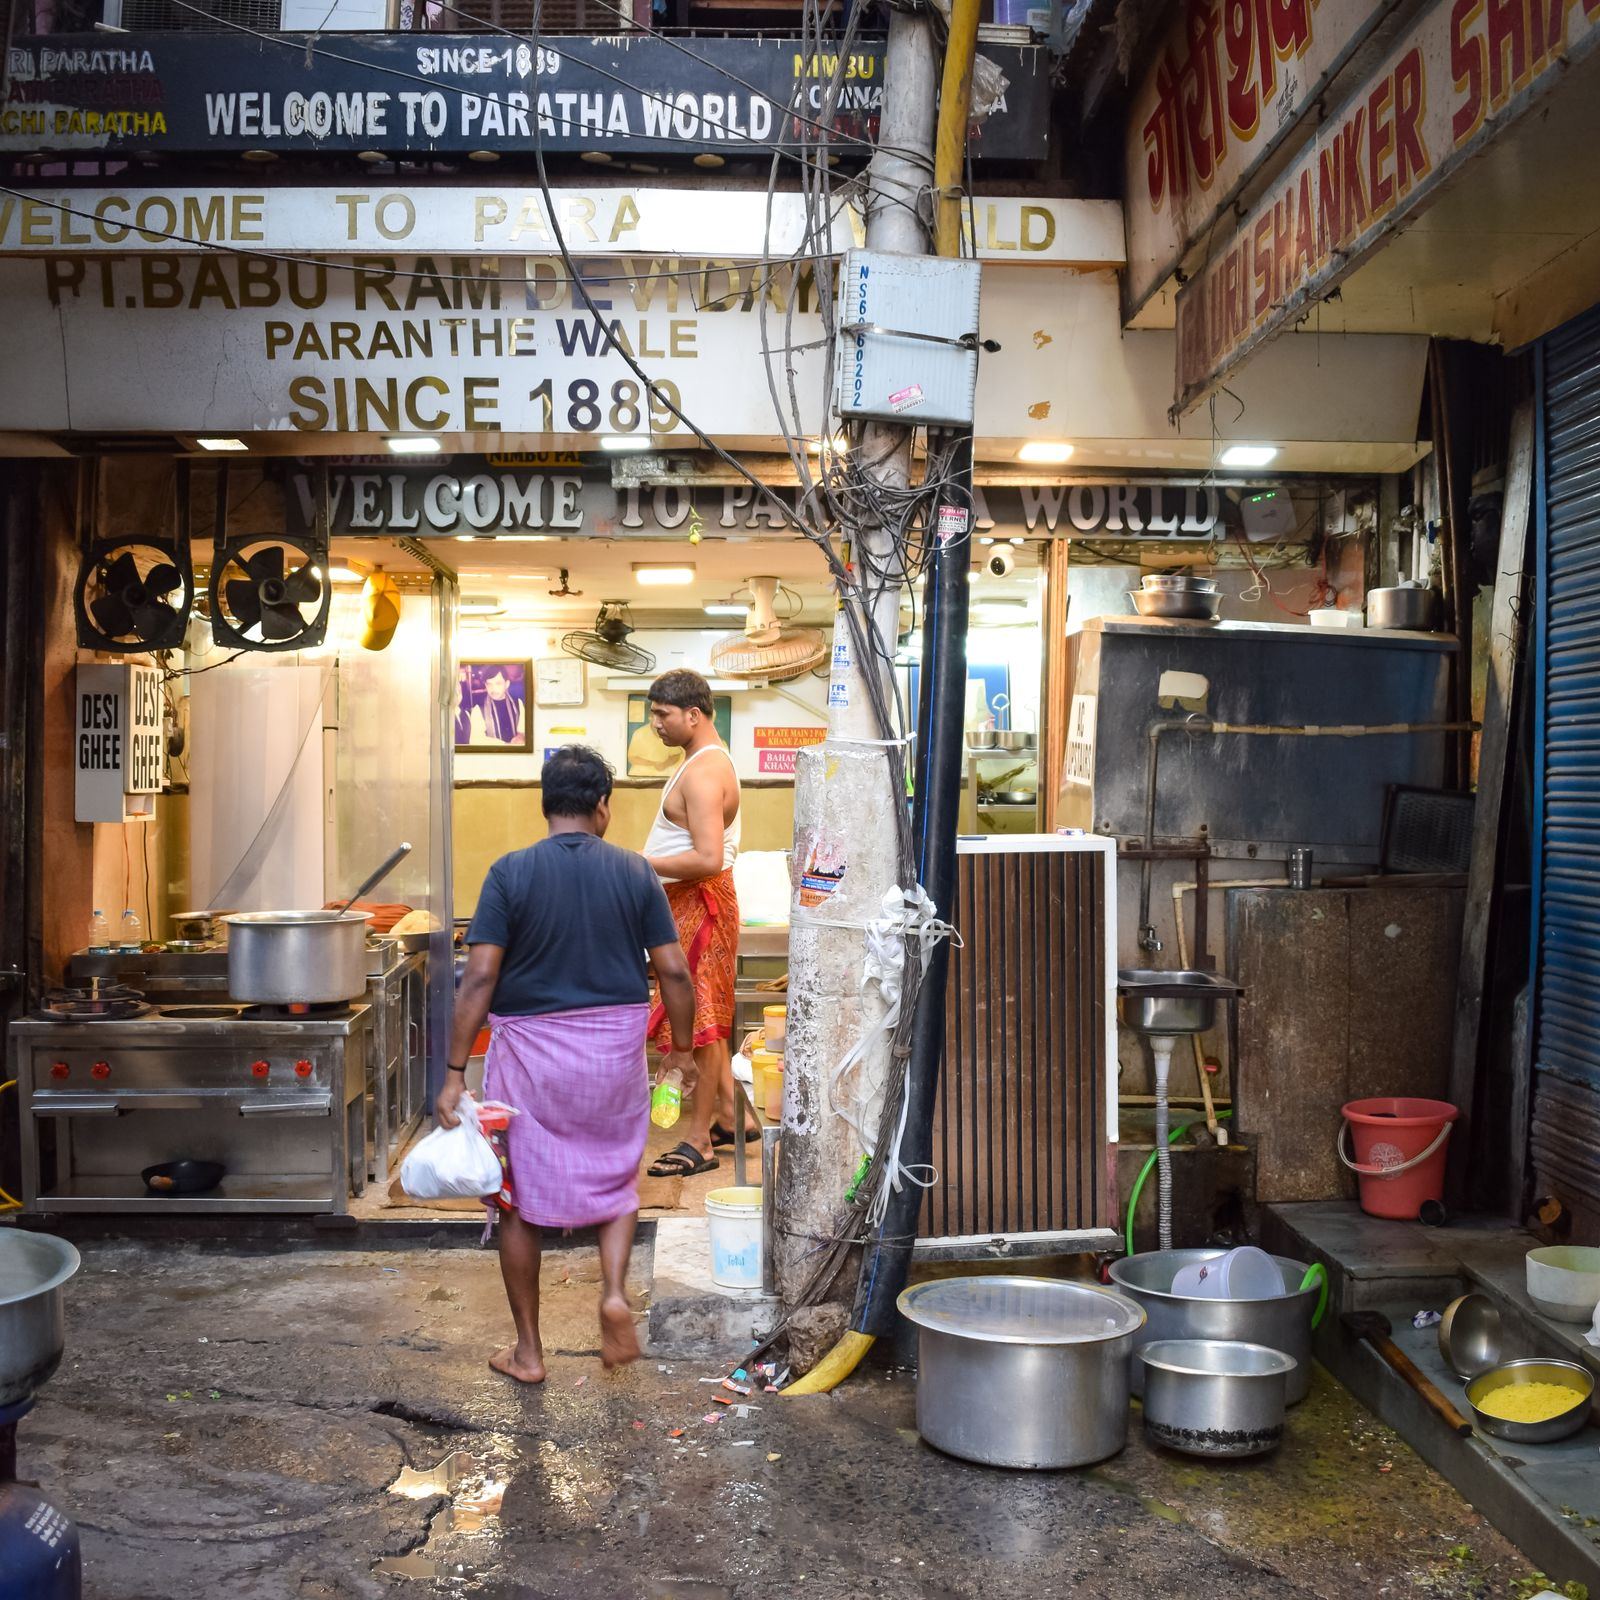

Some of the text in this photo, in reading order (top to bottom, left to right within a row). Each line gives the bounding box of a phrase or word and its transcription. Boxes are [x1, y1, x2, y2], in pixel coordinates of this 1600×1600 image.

[41, 49, 156, 74] PARATHA
[416, 47, 493, 75] SINCE
[0, 111, 168, 135] CHI PARATHA
[206, 91, 389, 137] WELCOME
[398, 92, 448, 137] TO
[461, 92, 632, 138] PARATHA
[642, 94, 773, 140] WORLD
[336, 194, 416, 240] TO
[354, 256, 500, 311] RAM
[265, 318, 699, 360] PARANTHE WALE
[289, 376, 682, 433] SINCE 1889
[293, 474, 584, 530] WELCOME
[622, 485, 691, 529] TO
[1020, 486, 1222, 533] WORLD
[82, 694, 119, 729] DESI
[135, 671, 160, 727] DESI
[79, 734, 121, 770] GHEE
[133, 734, 160, 790] GHEE
